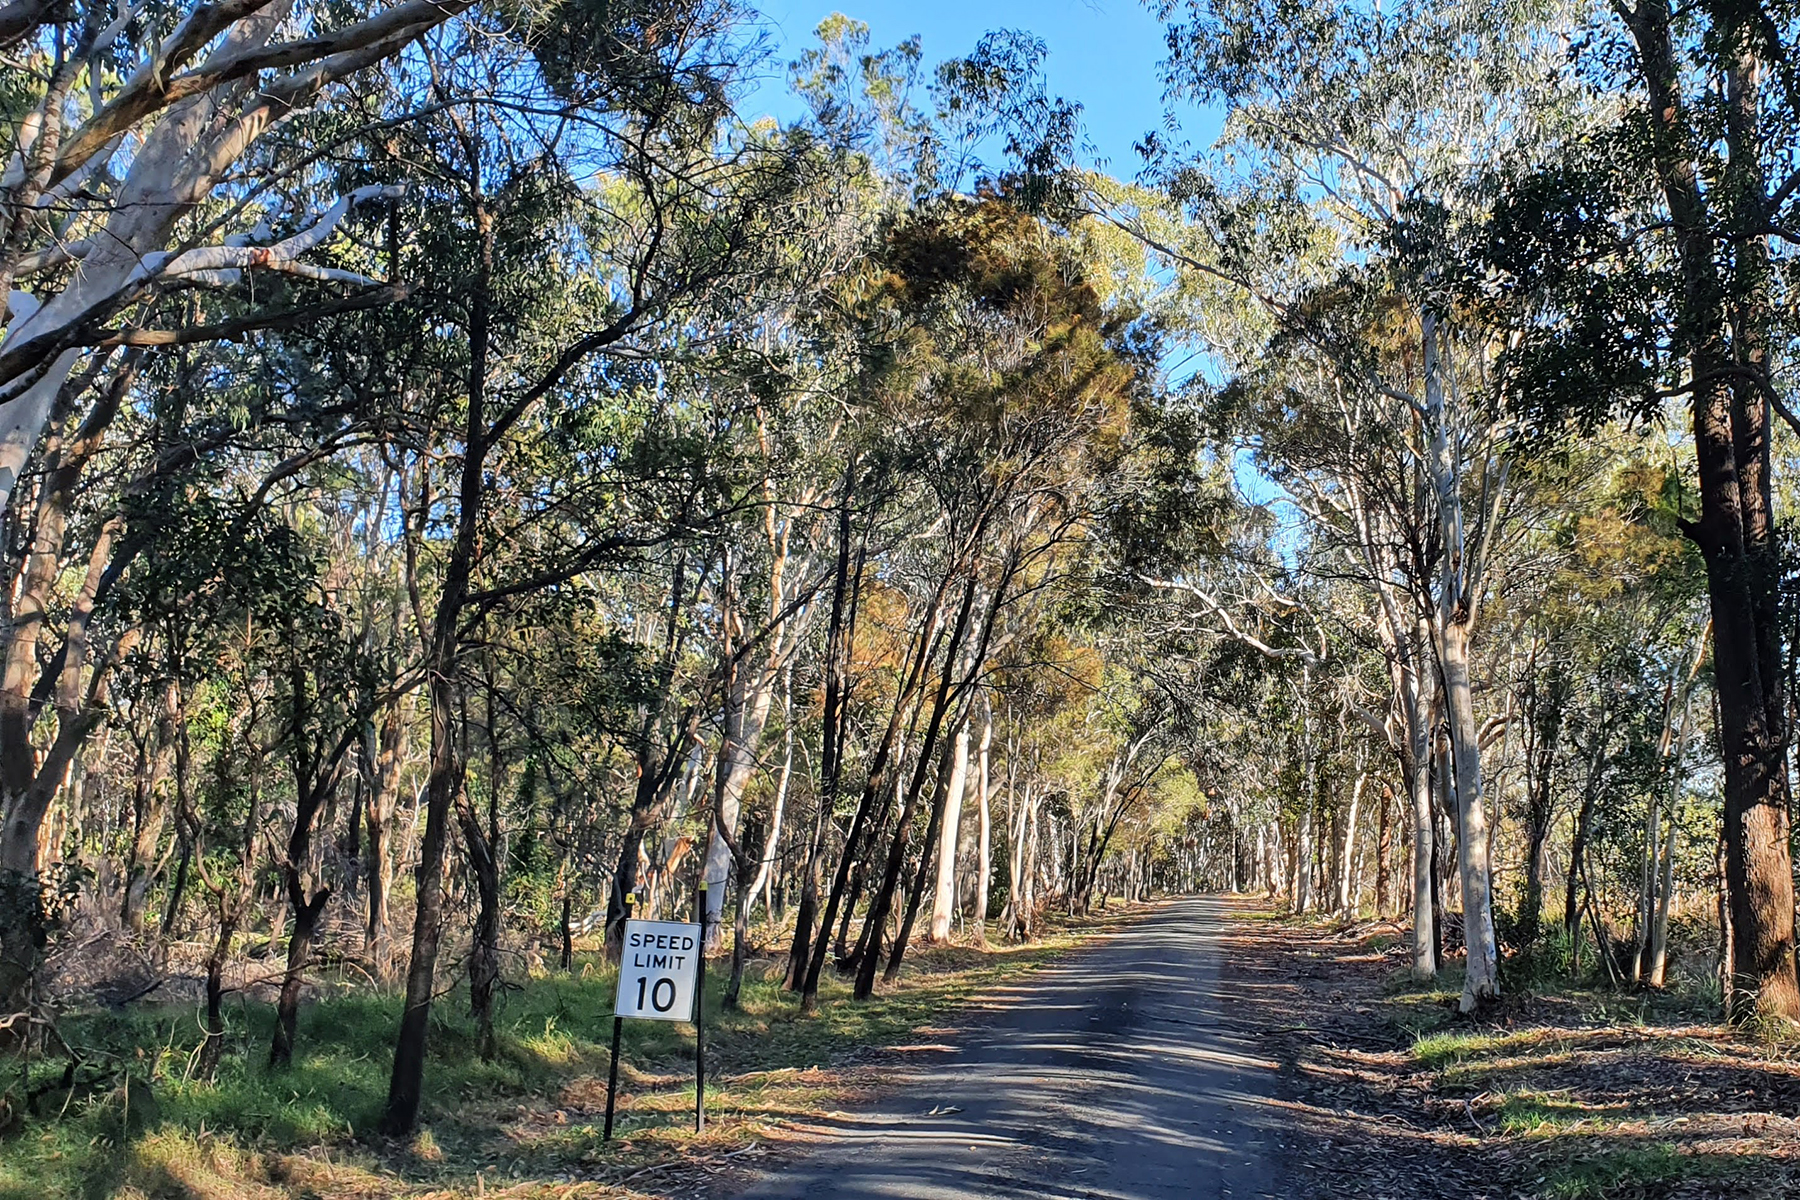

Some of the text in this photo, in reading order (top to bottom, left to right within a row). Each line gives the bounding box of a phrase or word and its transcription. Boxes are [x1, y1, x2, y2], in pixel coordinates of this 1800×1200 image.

[630, 933, 693, 951] SPEED
[634, 953, 685, 970] LIMIT
[637, 976, 676, 1012] 10
